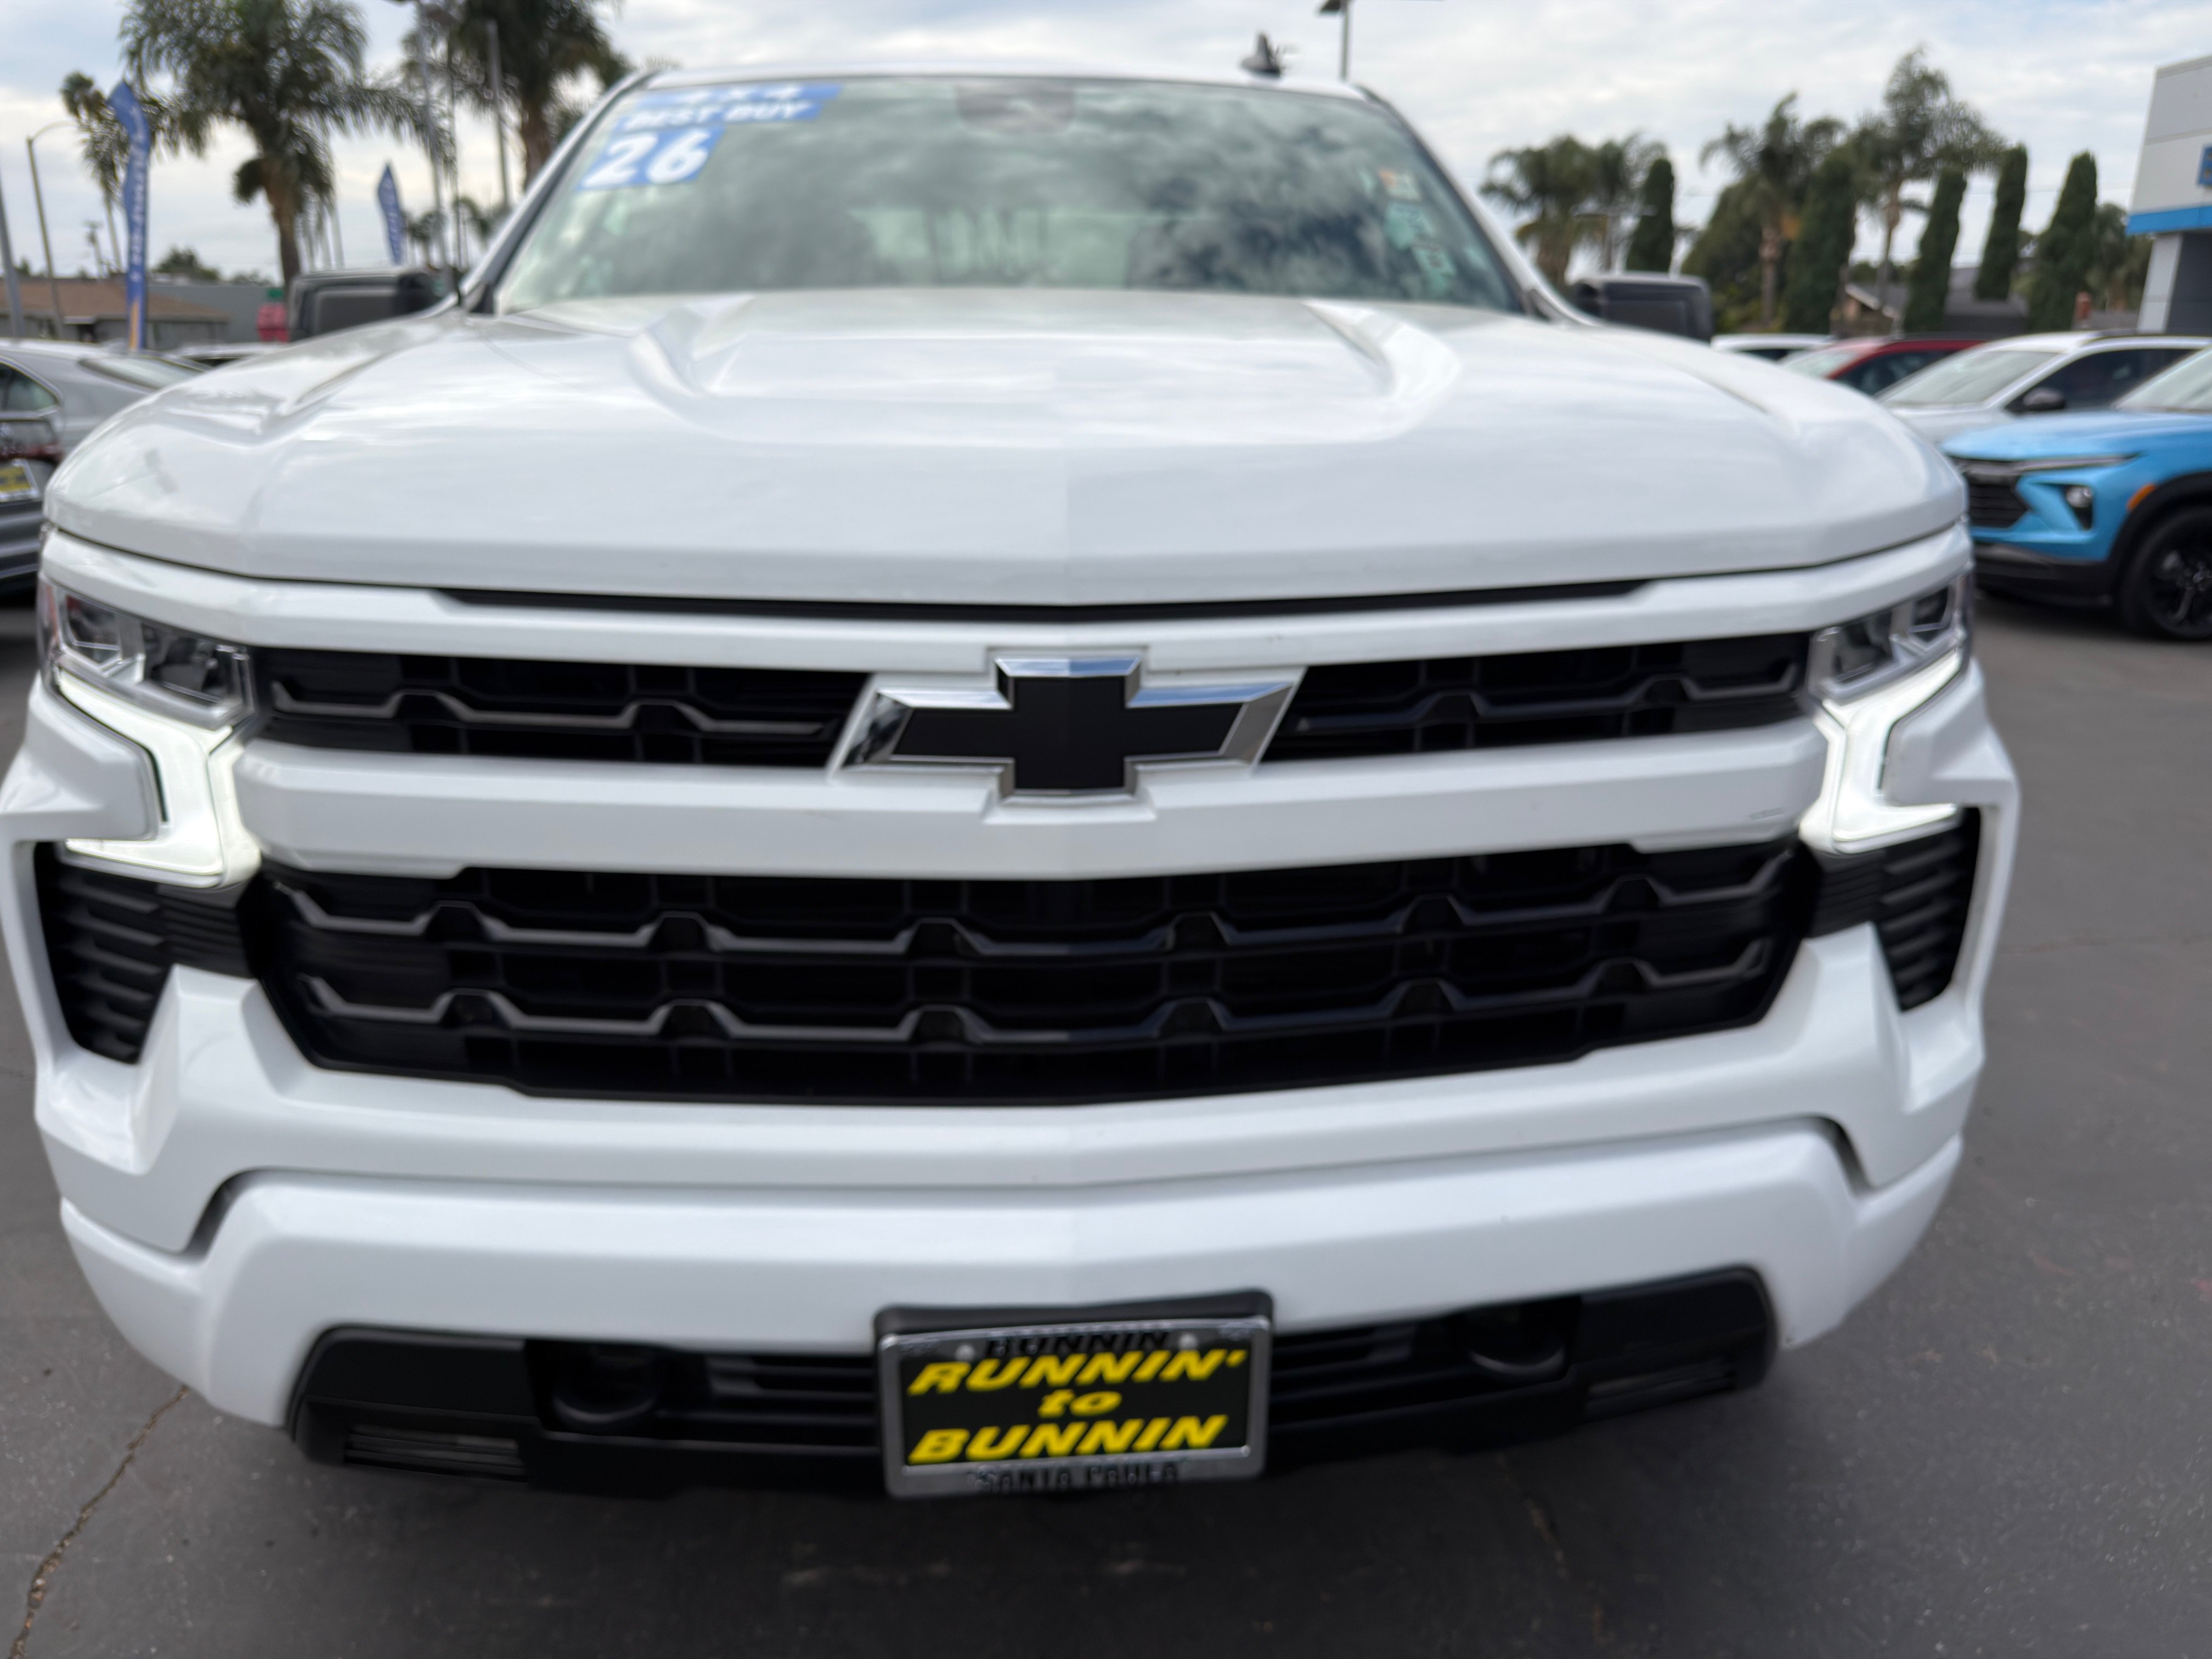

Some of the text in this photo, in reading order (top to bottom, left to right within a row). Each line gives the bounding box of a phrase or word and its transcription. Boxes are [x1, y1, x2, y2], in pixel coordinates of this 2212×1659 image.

[582, 128, 712, 186] 26
[907, 1348, 1248, 1396] RUNNIN'
[1037, 1388, 1122, 1419] to
[908, 1413, 1228, 1465] BUNNIN
